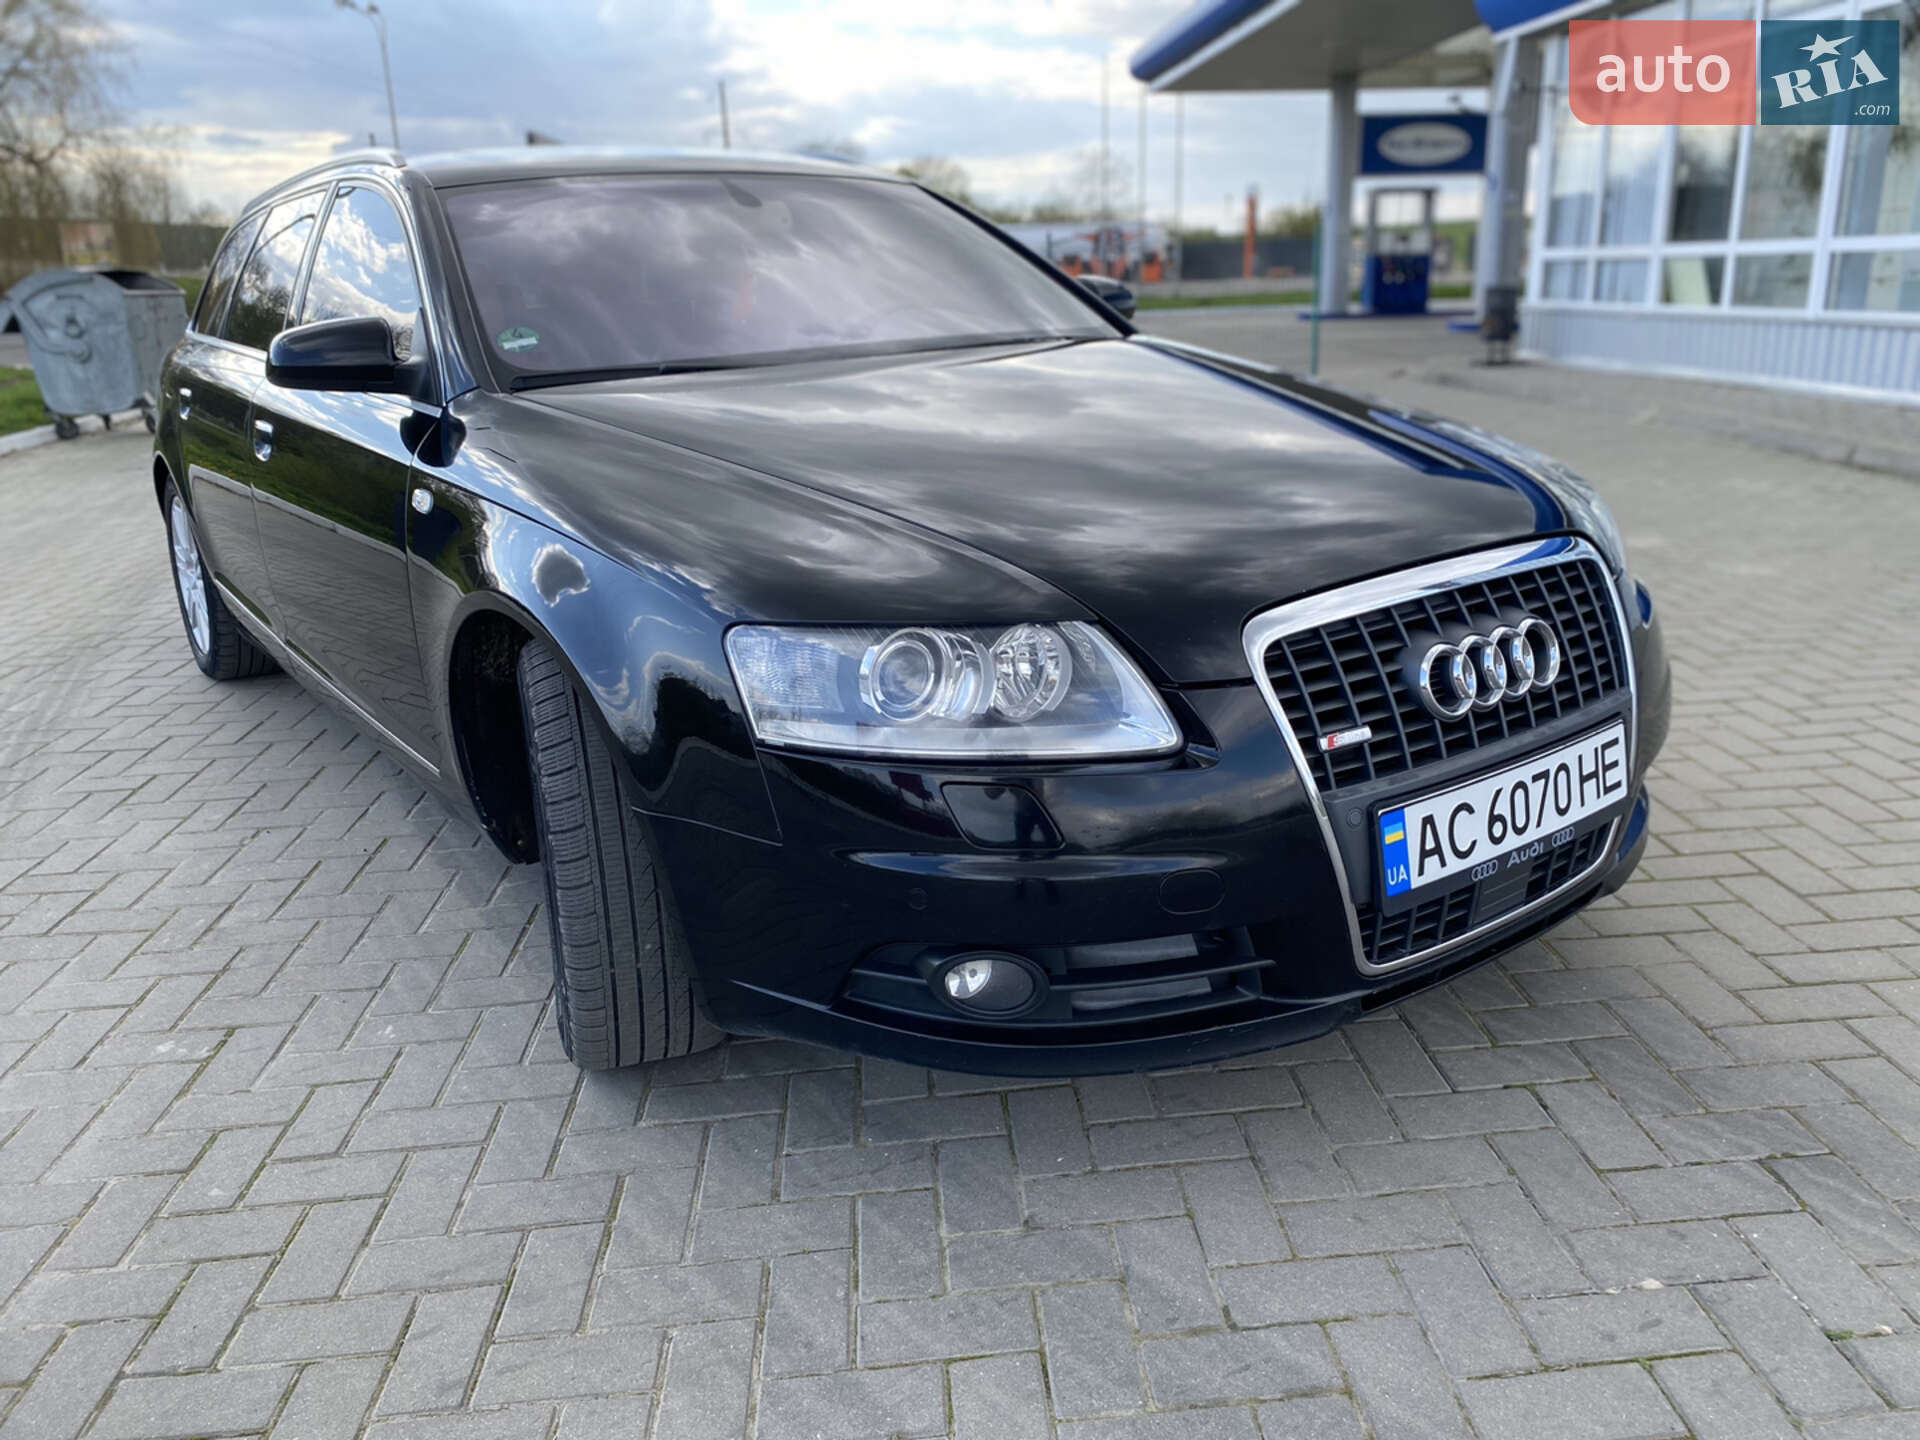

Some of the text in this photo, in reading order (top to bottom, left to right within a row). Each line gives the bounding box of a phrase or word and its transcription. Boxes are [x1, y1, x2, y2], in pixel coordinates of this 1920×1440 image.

[1417, 737, 1622, 877] AC 6070 HE
[1506, 841, 1544, 868] Audi
[1387, 868, 1408, 886] UA
